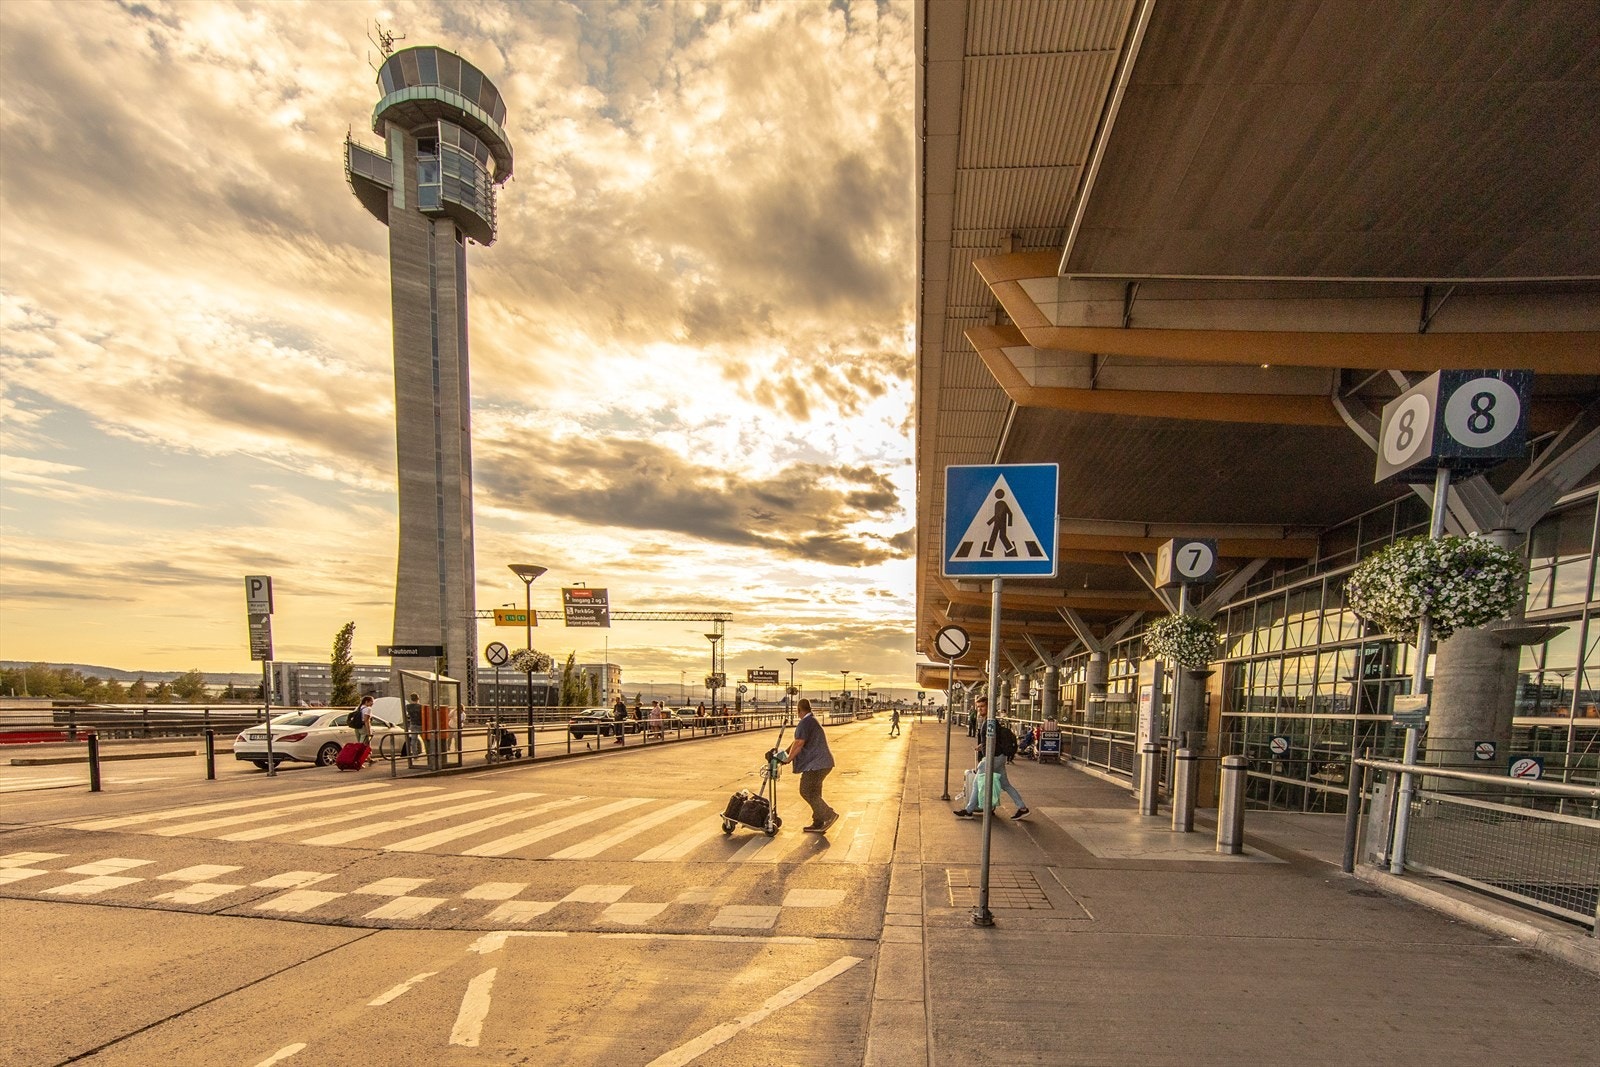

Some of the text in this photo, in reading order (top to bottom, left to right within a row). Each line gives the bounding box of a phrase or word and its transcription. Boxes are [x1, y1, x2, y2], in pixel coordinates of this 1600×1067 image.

[1467, 391, 1497, 434] 8
[1396, 409, 1415, 451] 8
[1162, 552, 1168, 576] 7
[1188, 549, 1202, 570] 7
[250, 578, 262, 598] P
